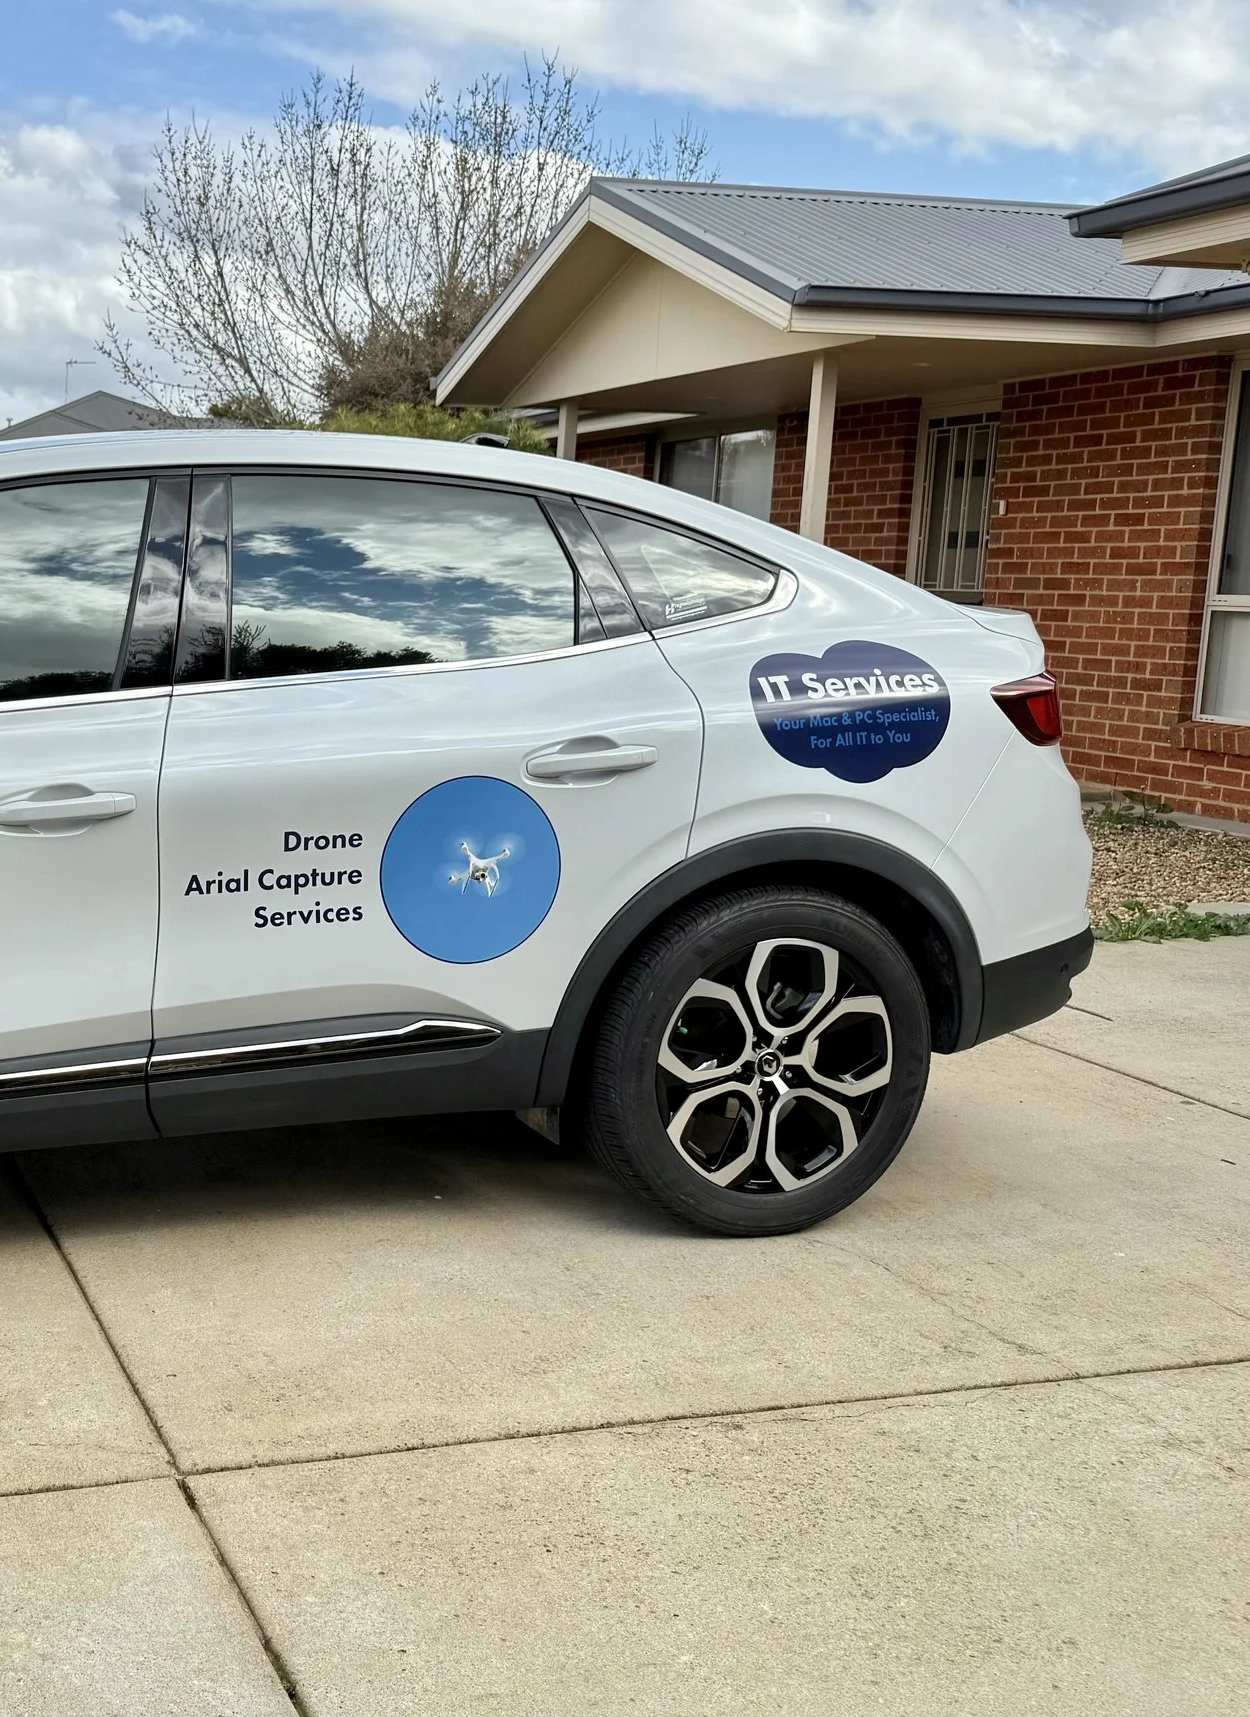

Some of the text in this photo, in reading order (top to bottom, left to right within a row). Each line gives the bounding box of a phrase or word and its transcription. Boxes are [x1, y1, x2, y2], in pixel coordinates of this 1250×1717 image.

[757, 668, 940, 703] IT Services
[773, 707, 940, 731] Your Mac & PC Specialist,
[810, 730, 911, 749] For All IT to You
[283, 831, 363, 852] Drone
[184, 868, 363, 896] Arial Capture
[253, 901, 364, 929] Services
